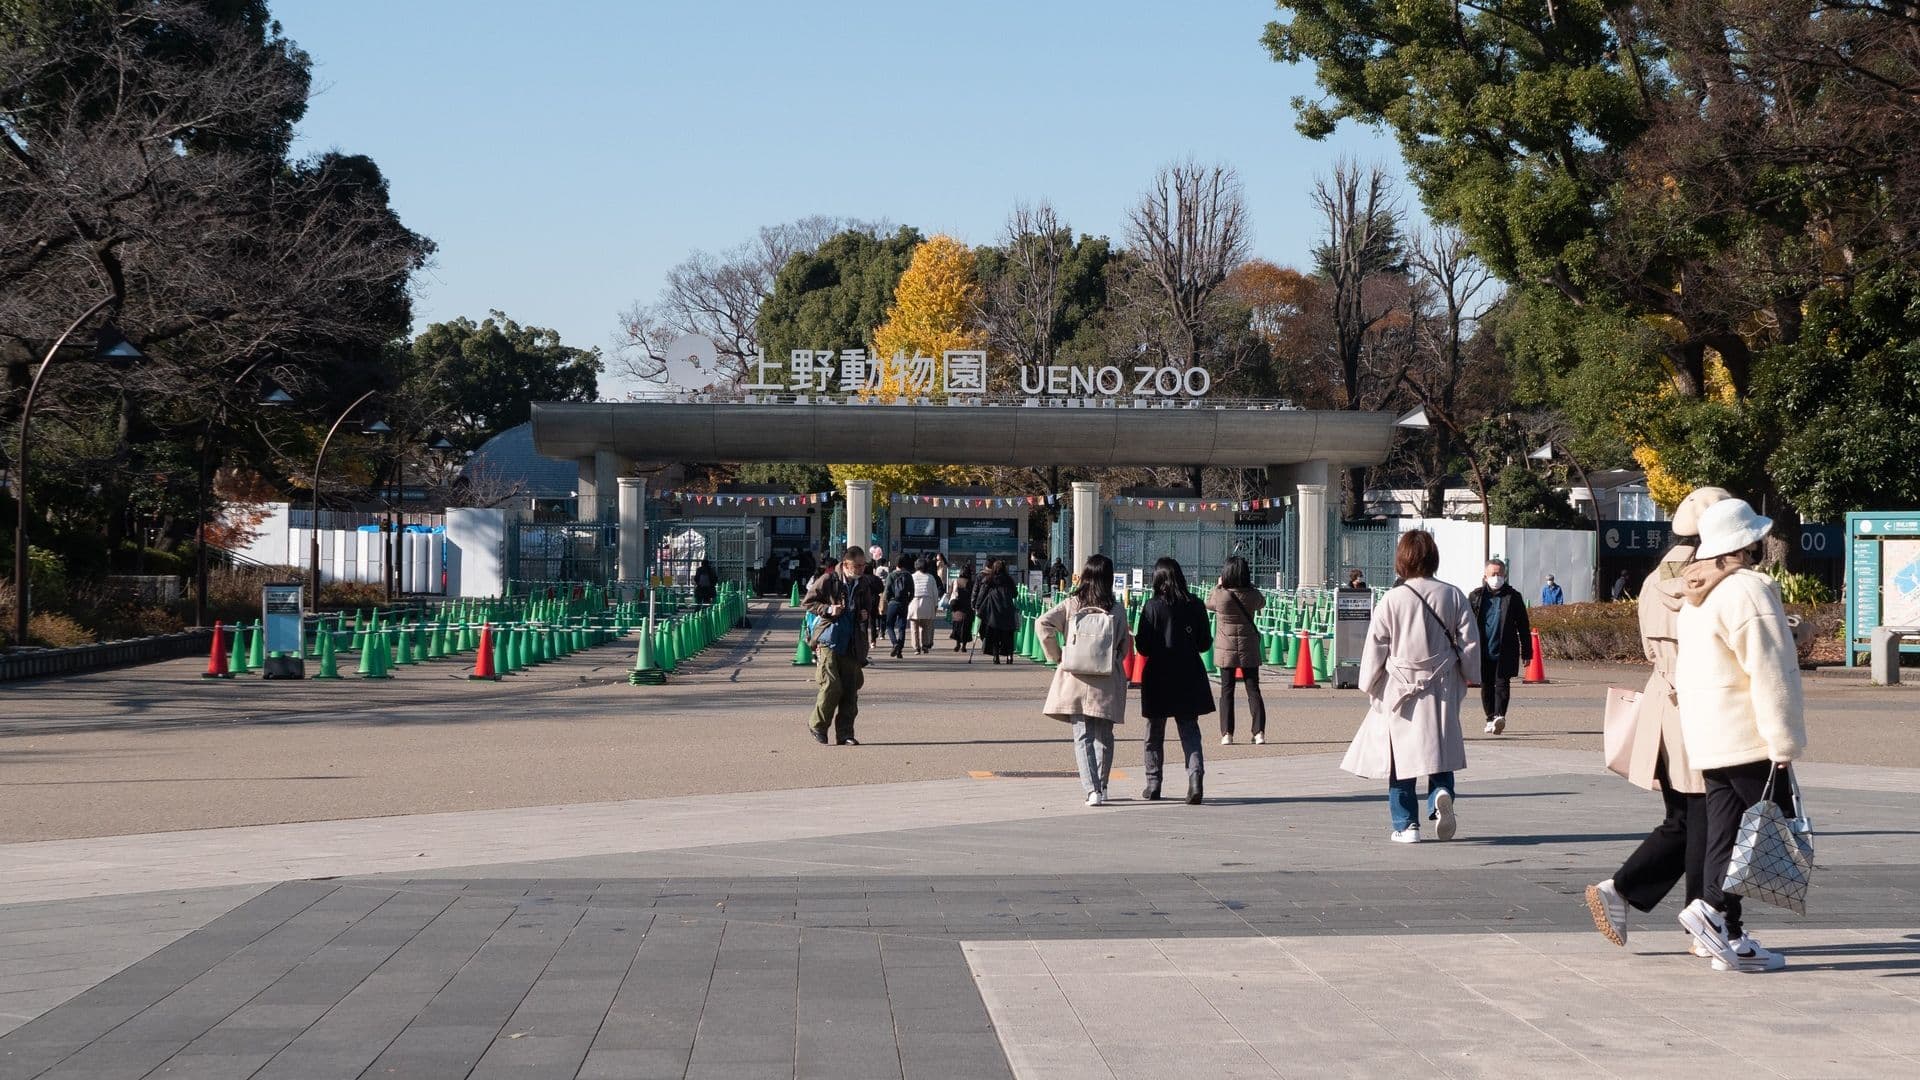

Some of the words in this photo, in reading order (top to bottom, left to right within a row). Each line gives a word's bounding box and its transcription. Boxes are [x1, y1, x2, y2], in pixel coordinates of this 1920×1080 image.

[741, 348, 986, 393] 上野動物園
[1021, 366, 1123, 395] UENO
[1132, 366, 1210, 396] ZOO
